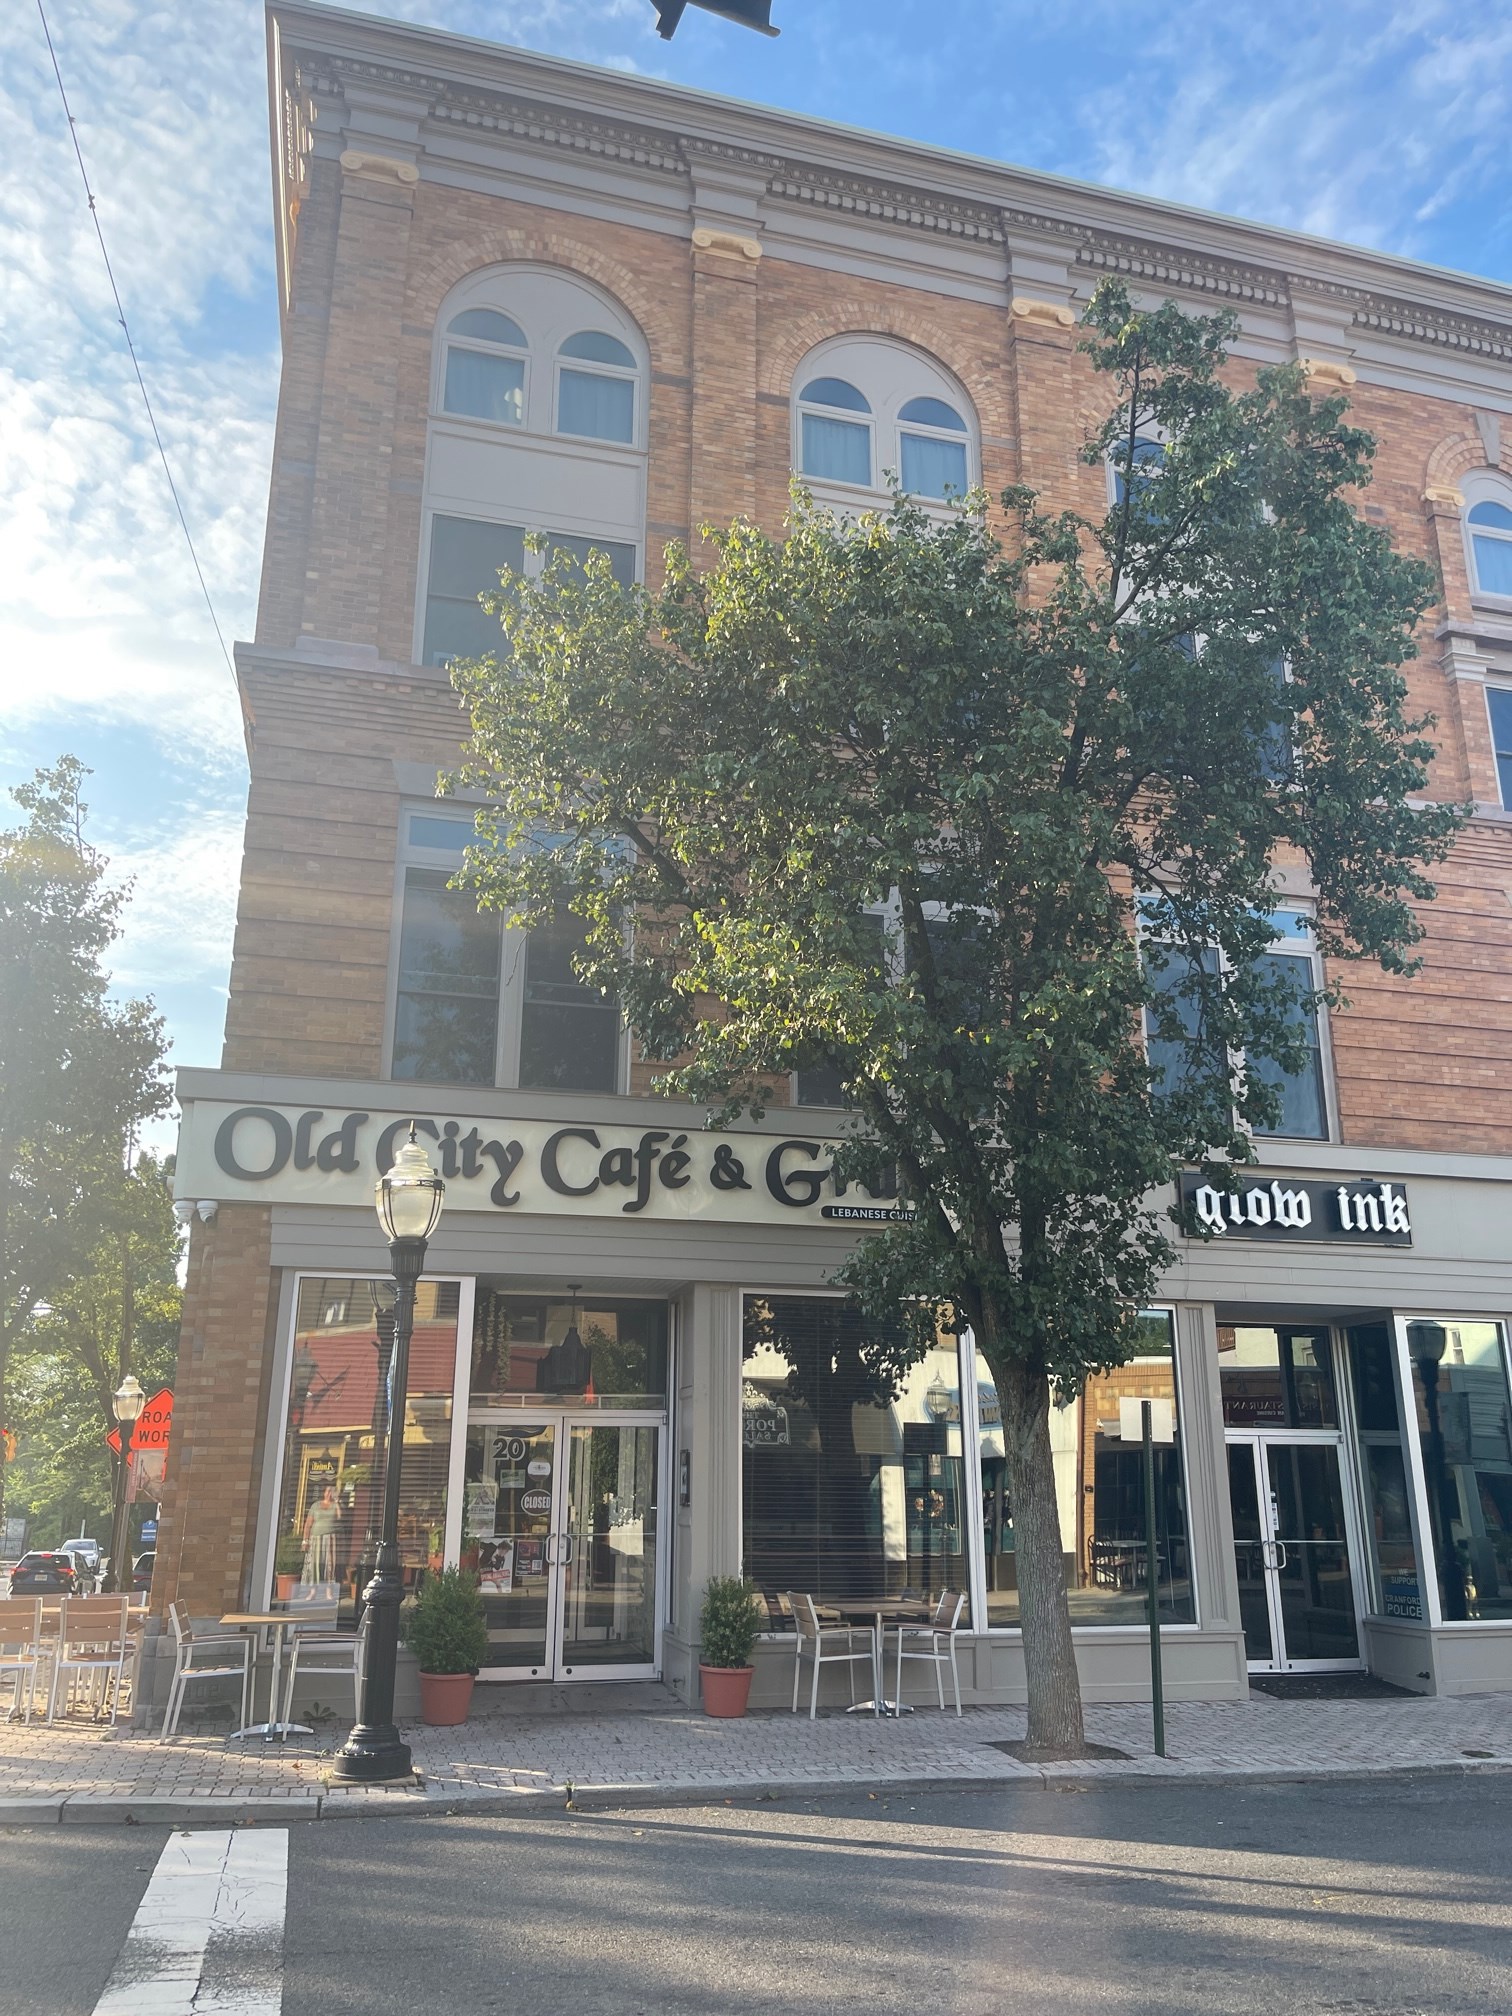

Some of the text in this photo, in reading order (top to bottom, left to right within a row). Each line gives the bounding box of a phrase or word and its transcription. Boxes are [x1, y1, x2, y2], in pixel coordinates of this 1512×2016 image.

[214, 1107, 370, 1181] Old
[377, 1118, 525, 1206] City
[541, 1128, 691, 1212] Café
[711, 1144, 752, 1189] &
[1196, 1180, 1411, 1233] glow ink
[832, 1207, 918, 1221] LEBANESE CUISI
[142, 1411, 172, 1424] ROA
[139, 1430, 170, 1442] WOR
[492, 1436, 526, 1461] 20
[524, 1495, 551, 1509] CLOSED
[1398, 1568, 1409, 1576] WE
[1384, 1594, 1421, 1605] CRANFORD
[1387, 1603, 1422, 1617] POLICE
